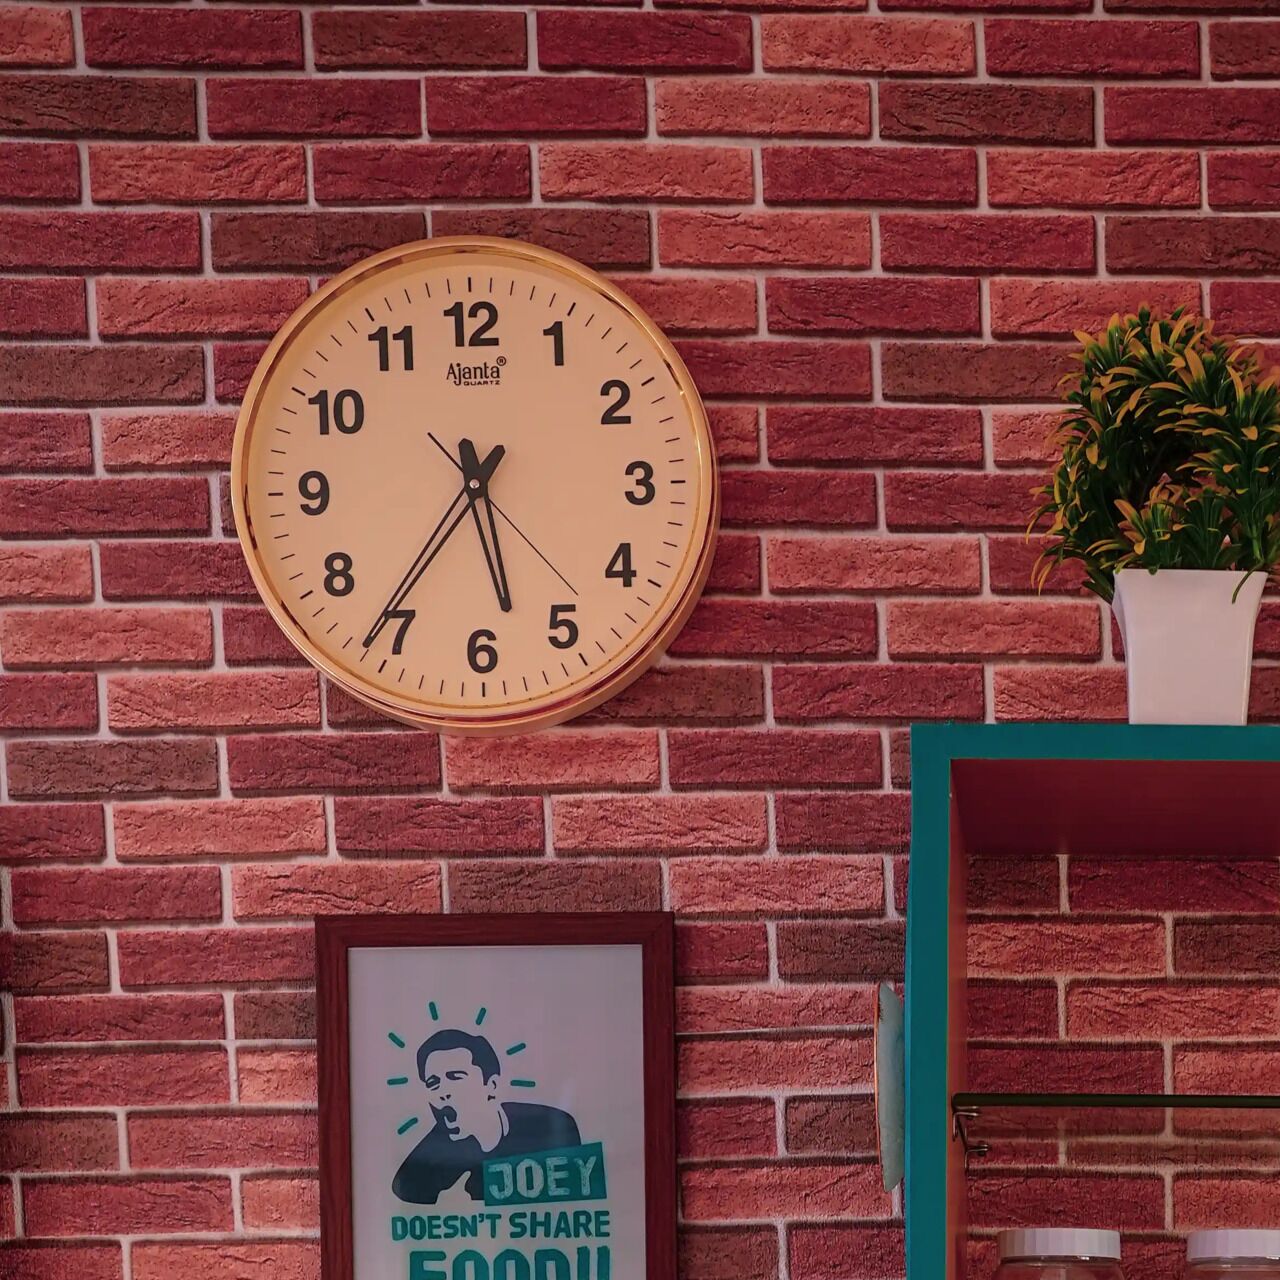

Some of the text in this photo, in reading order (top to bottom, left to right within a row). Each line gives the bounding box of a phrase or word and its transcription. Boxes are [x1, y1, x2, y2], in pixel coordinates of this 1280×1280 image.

[443, 302, 500, 347] 12
[543, 321, 565, 366] 1
[368, 325, 415, 371] 11
[446, 360, 501, 387] Ajanta
[308, 389, 365, 436] 10
[600, 379, 632, 425] 2
[299, 471, 331, 516] 9
[624, 461, 656, 505] 3
[323, 552, 355, 597] 8
[604, 543, 637, 588] 4
[386, 609, 416, 655] 7
[548, 604, 579, 649] 5
[467, 629, 499, 674] 6
[487, 1154, 598, 1200] JOEY
[391, 1210, 611, 1241] DOESN'T SHARE
